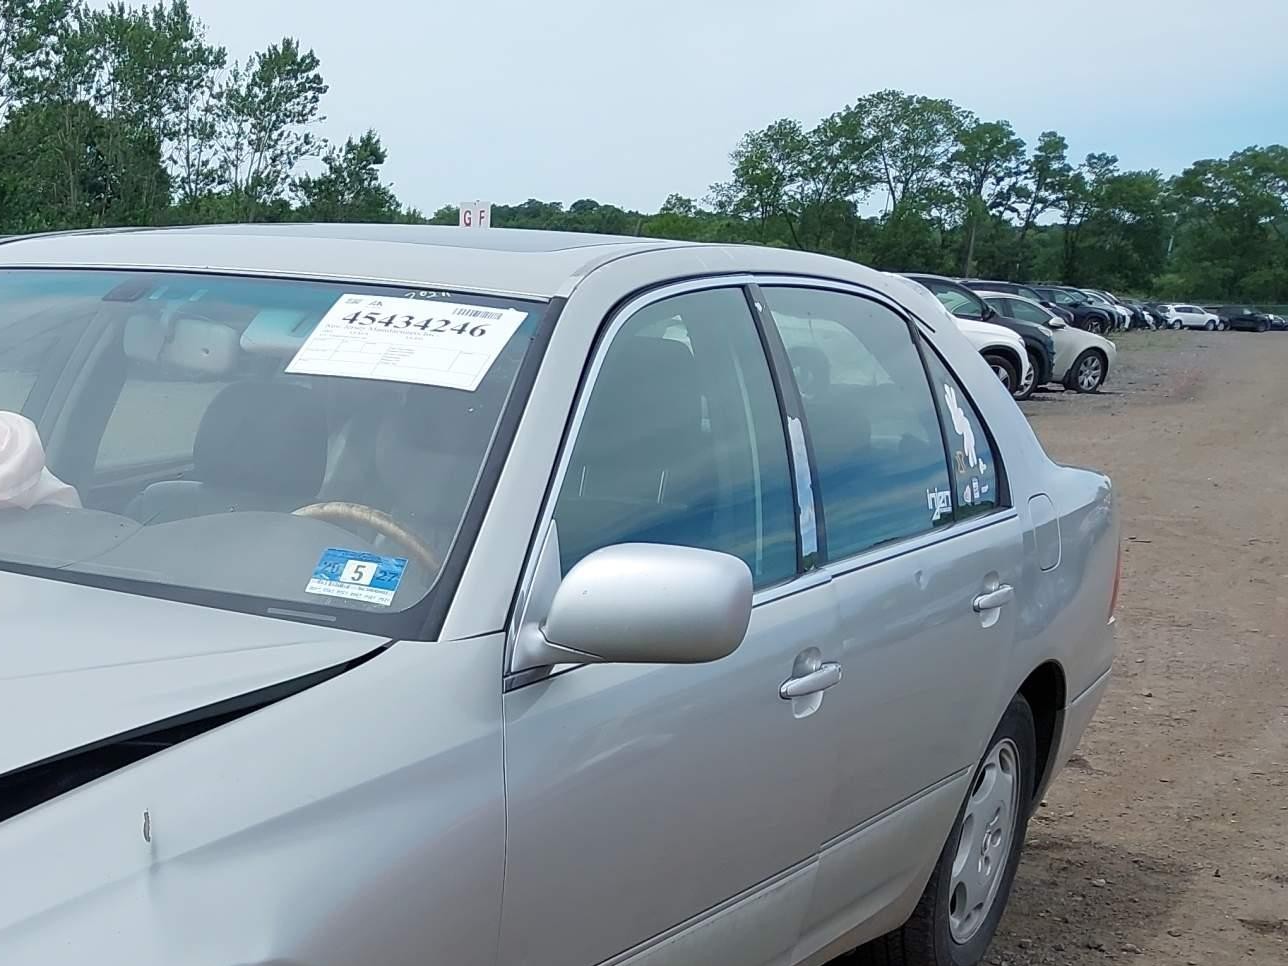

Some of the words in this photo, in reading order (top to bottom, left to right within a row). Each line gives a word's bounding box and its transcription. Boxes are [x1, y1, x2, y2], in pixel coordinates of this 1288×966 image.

[463, 210, 471, 227] G
[479, 210, 485, 226] F
[342, 310, 492, 337] 45434246
[351, 564, 367, 582] 5
[376, 570, 399, 583] 27
